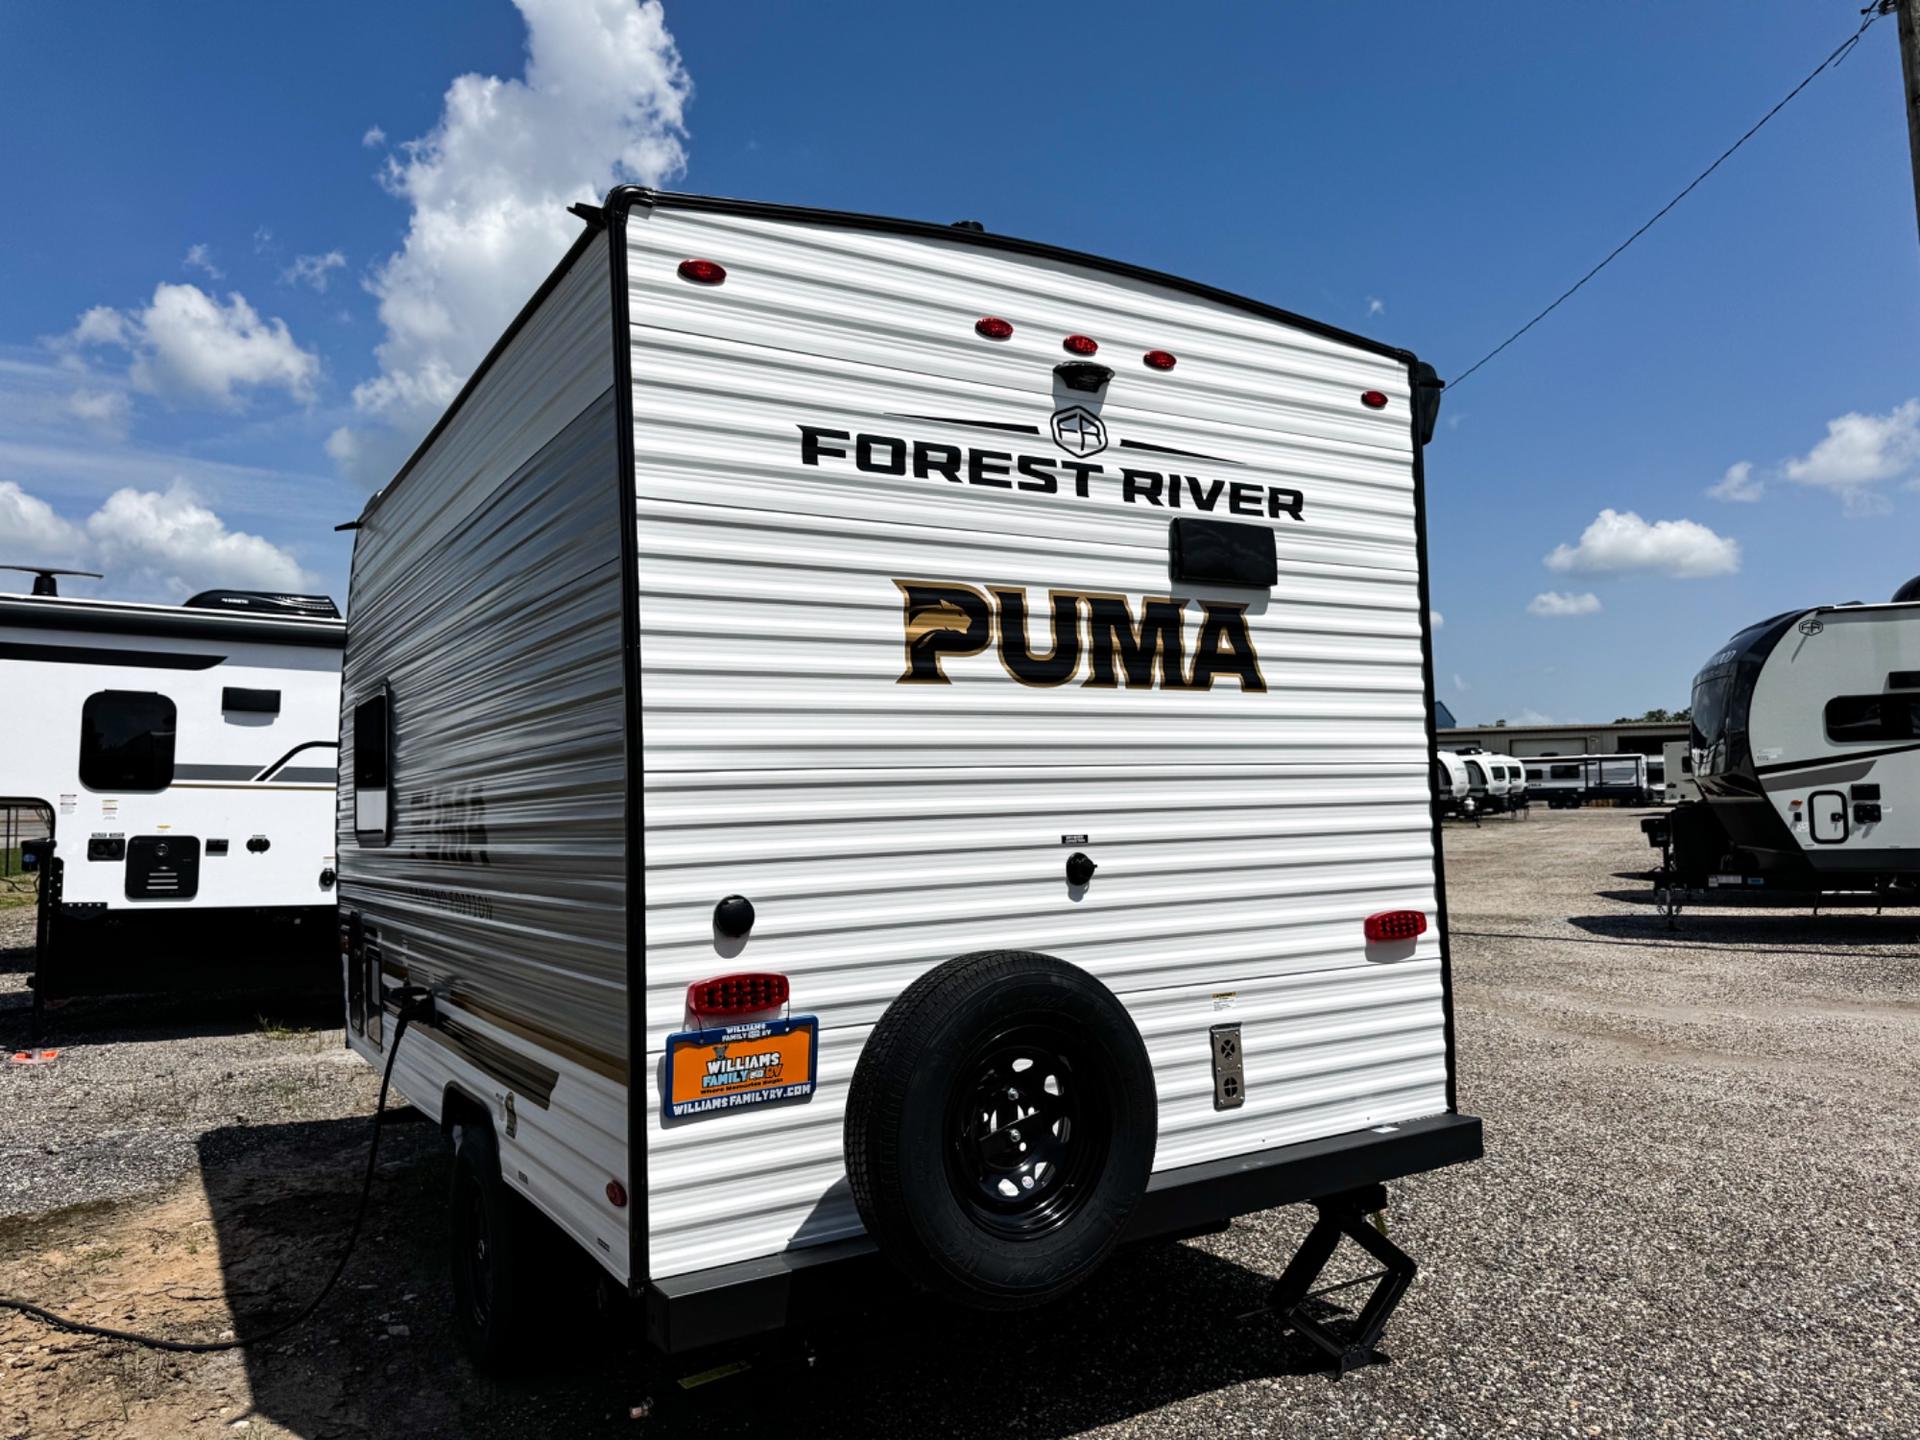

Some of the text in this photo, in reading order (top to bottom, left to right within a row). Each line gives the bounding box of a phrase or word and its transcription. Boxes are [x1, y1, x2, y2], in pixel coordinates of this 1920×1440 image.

[796, 423, 1306, 522] FOREST RIVER
[890, 579, 1268, 693] PUMA
[703, 1070, 748, 1088] FAMILY
[707, 1052, 780, 1074] WILLIAMS
